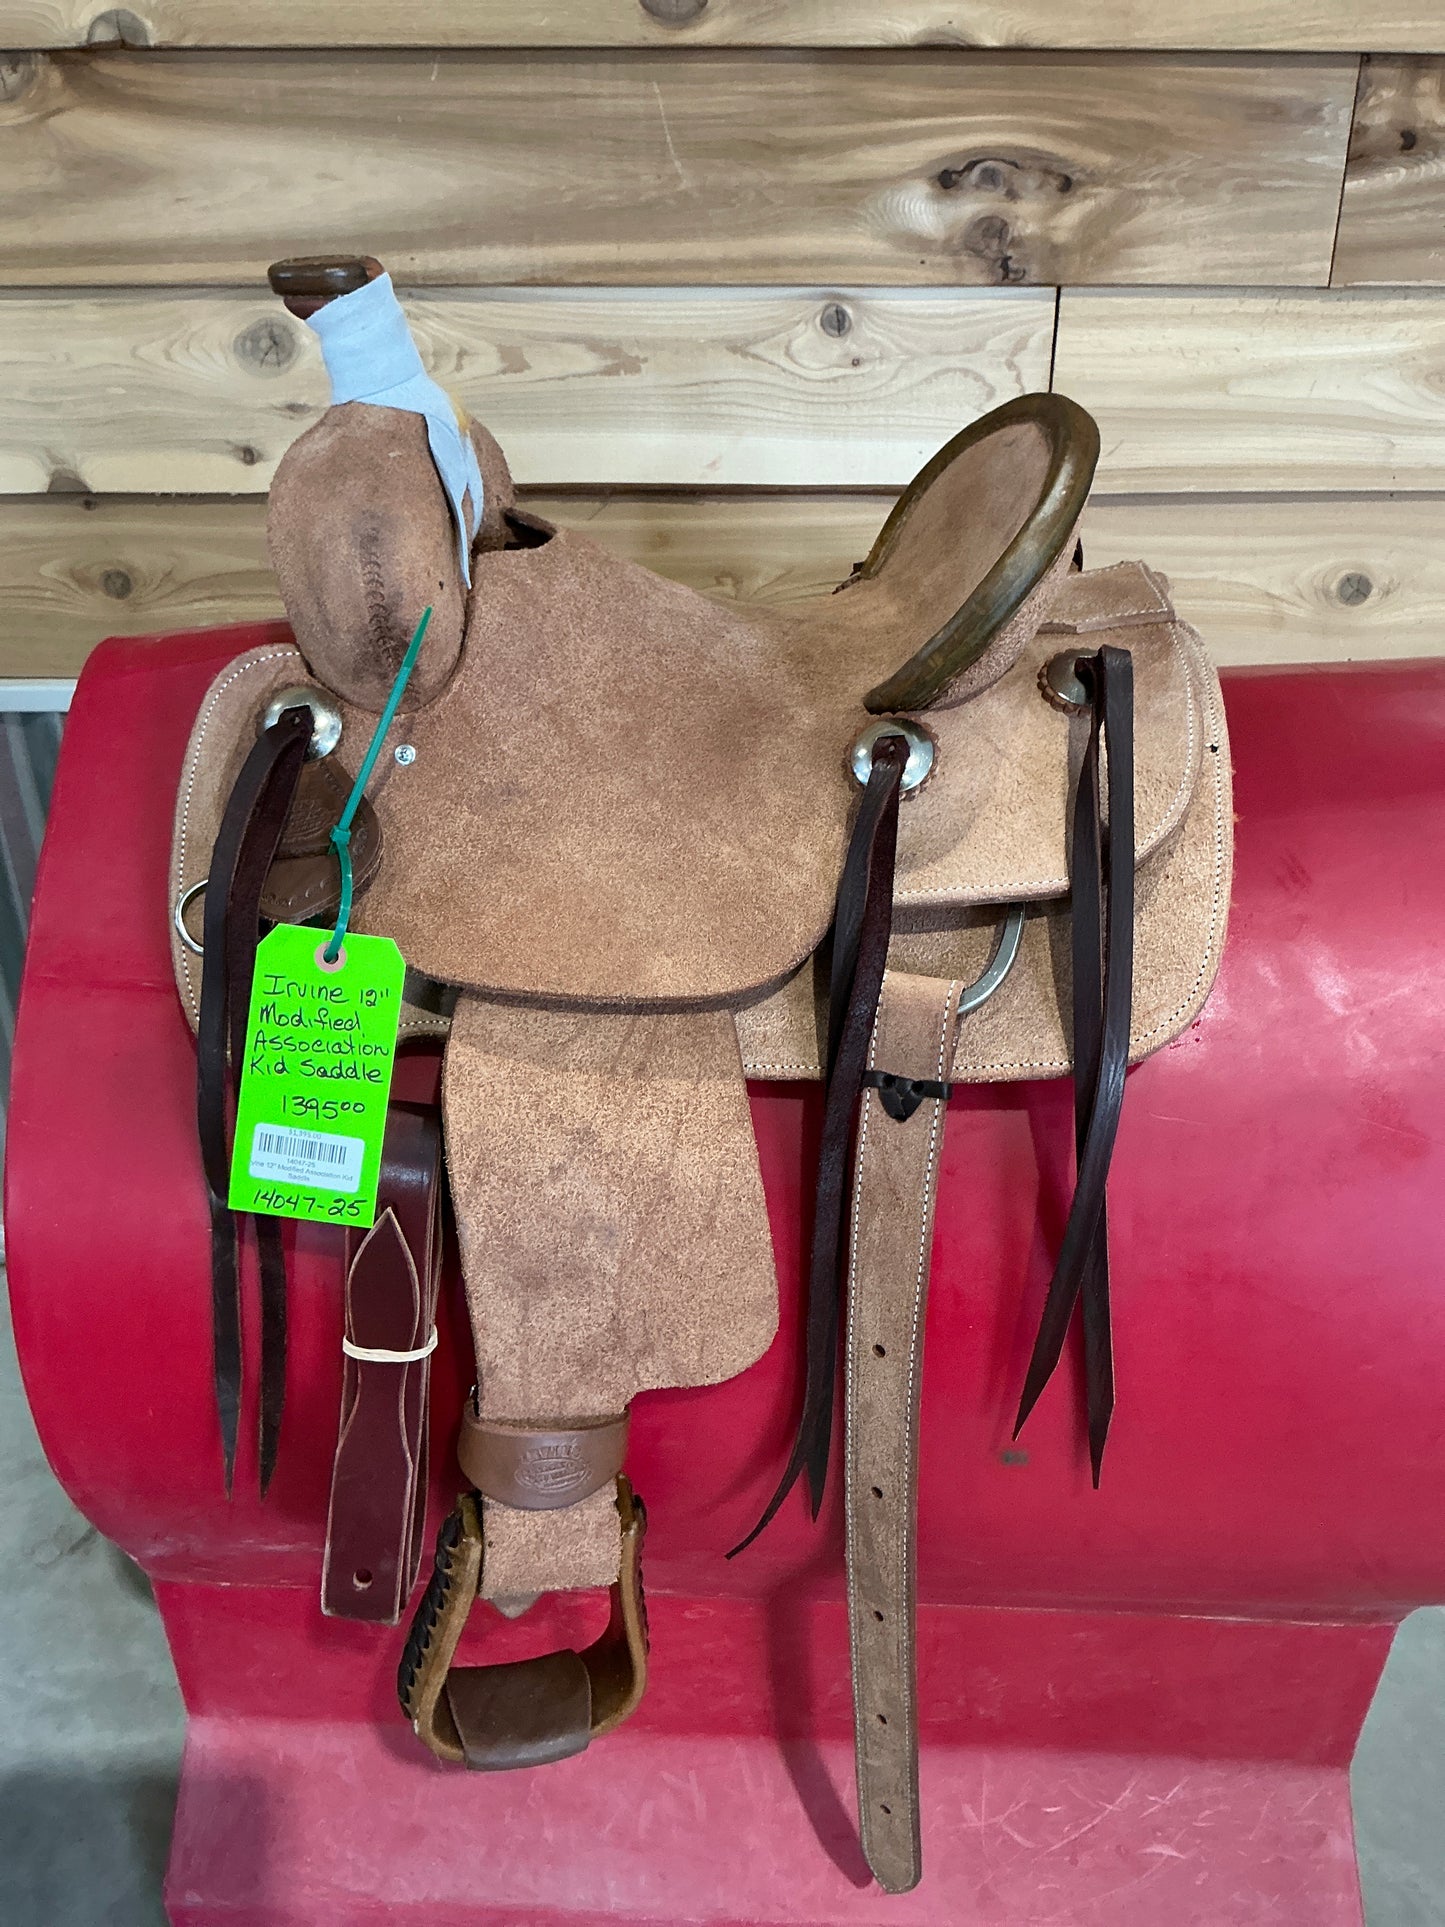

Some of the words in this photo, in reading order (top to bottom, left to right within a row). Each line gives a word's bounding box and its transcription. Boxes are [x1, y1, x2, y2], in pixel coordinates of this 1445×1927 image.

[263, 974, 350, 1004] Irvine
[359, 988, 391, 1008] 12"
[259, 1002, 362, 1032] Modified
[253, 1029, 389, 1058] Association
[250, 1054, 290, 1075] Kid
[299, 1058, 384, 1083] Saddle
[277, 1164, 304, 1174] Modified
[305, 1169, 341, 1180] Association
[342, 1174, 353, 1182] Kid
[253, 1188, 368, 1217] 14047-25
